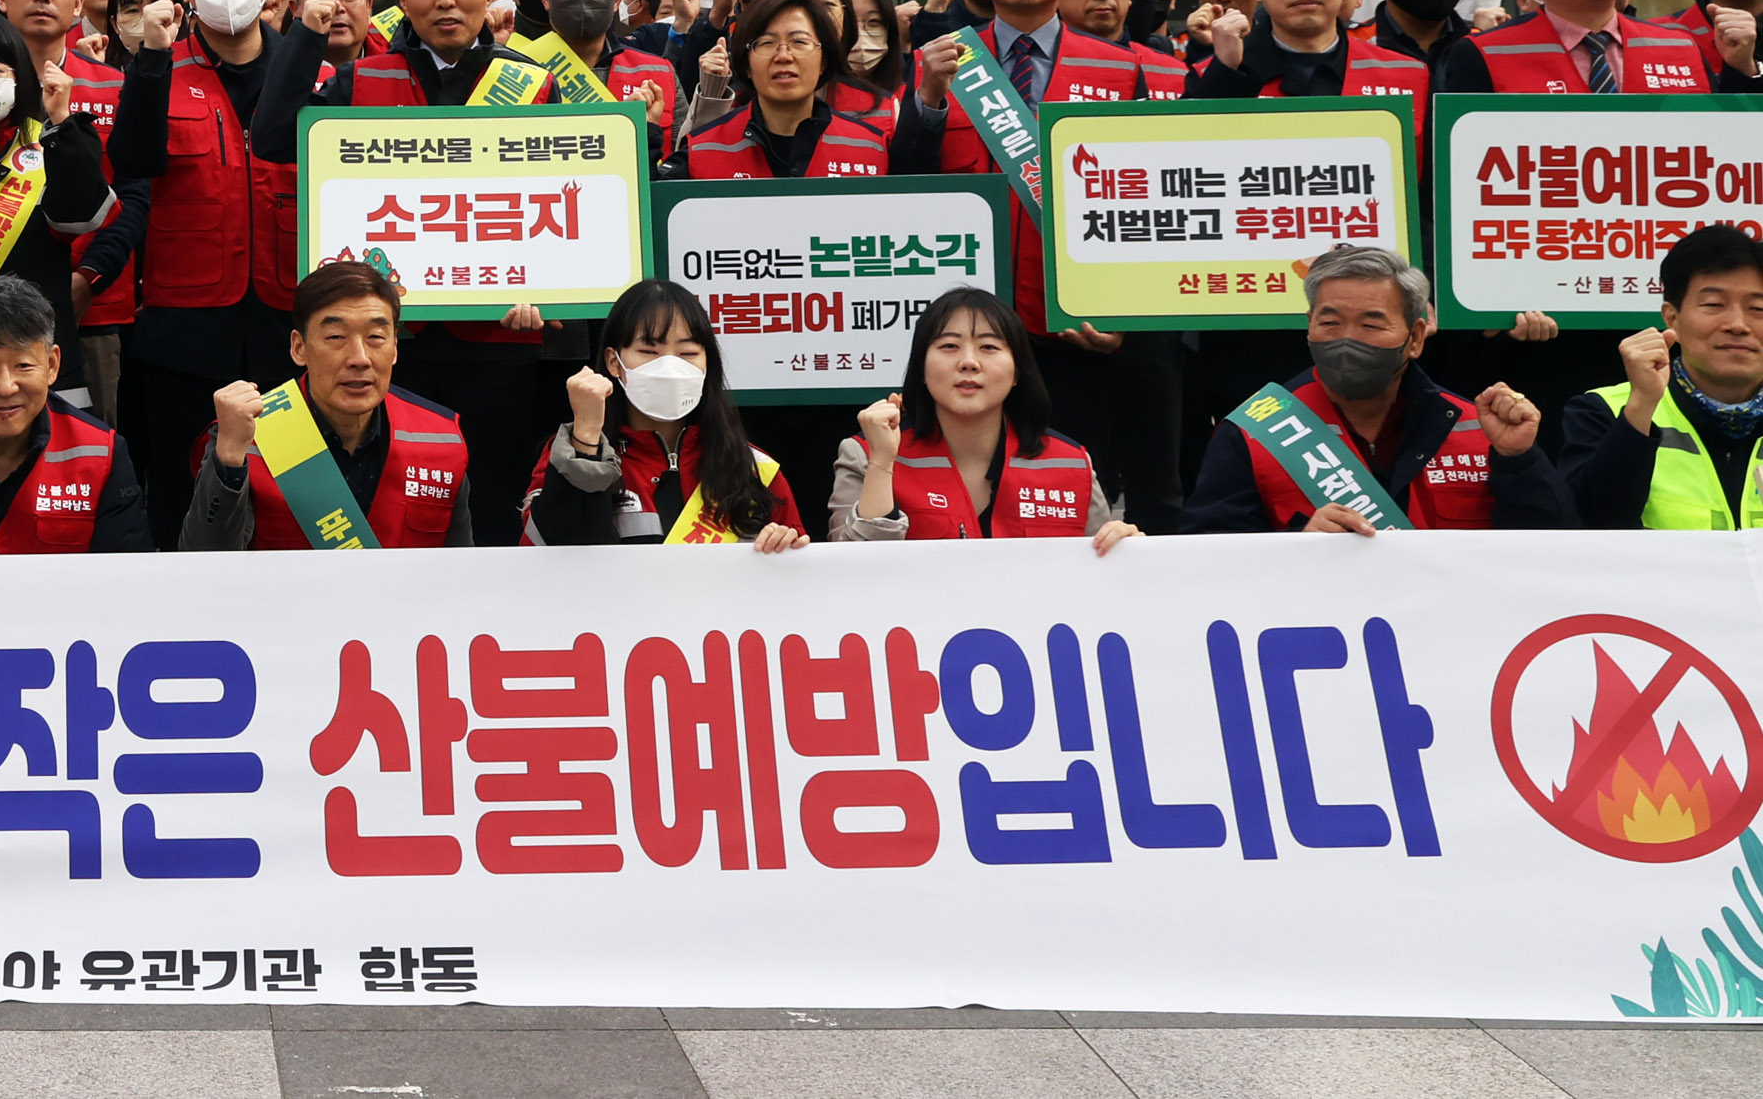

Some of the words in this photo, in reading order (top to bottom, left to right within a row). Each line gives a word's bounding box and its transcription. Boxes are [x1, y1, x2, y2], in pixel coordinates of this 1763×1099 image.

[1642, 62, 1691, 76] 산불예방
[1069, 82, 1121, 101] 산불예방
[1659, 76, 1697, 89] 전라남도
[69, 102, 114, 115] 산불예방
[958, 64, 994, 93] 그
[979, 88, 1037, 160] 시작은
[339, 137, 473, 164] 농산부산물
[498, 133, 607, 163] 논밭두렁
[827, 160, 878, 176] 산불예방
[1475, 144, 1763, 209] 산불예방에
[1084, 167, 1150, 201] 태울
[1160, 166, 1227, 200] 때는
[1237, 163, 1375, 198] 설마설마
[365, 181, 582, 243] 소각금지
[1082, 208, 1224, 244] 처벌받고
[1234, 202, 1380, 241] 후회막심
[1472, 219, 1531, 261] 모두
[682, 249, 804, 281] 이득없는
[808, 232, 981, 279] 논밭소각
[423, 265, 527, 287] 산불조심
[1177, 271, 1288, 295] 산불조심
[851, 300, 933, 332] 폐가
[1267, 414, 1313, 448] 그
[405, 465, 454, 485] 산불예방
[1445, 469, 1489, 483] 전라남도
[38, 483, 92, 498] 산불예방
[419, 484, 451, 499] 전라남도
[1018, 486, 1077, 503] 산불예방
[52, 498, 93, 513] 전라남도
[1036, 504, 1078, 519] 전라남도
[308, 614, 1443, 879] 산불예방입니다
[78, 947, 322, 992] 유관기관
[357, 946, 479, 994] 합동
